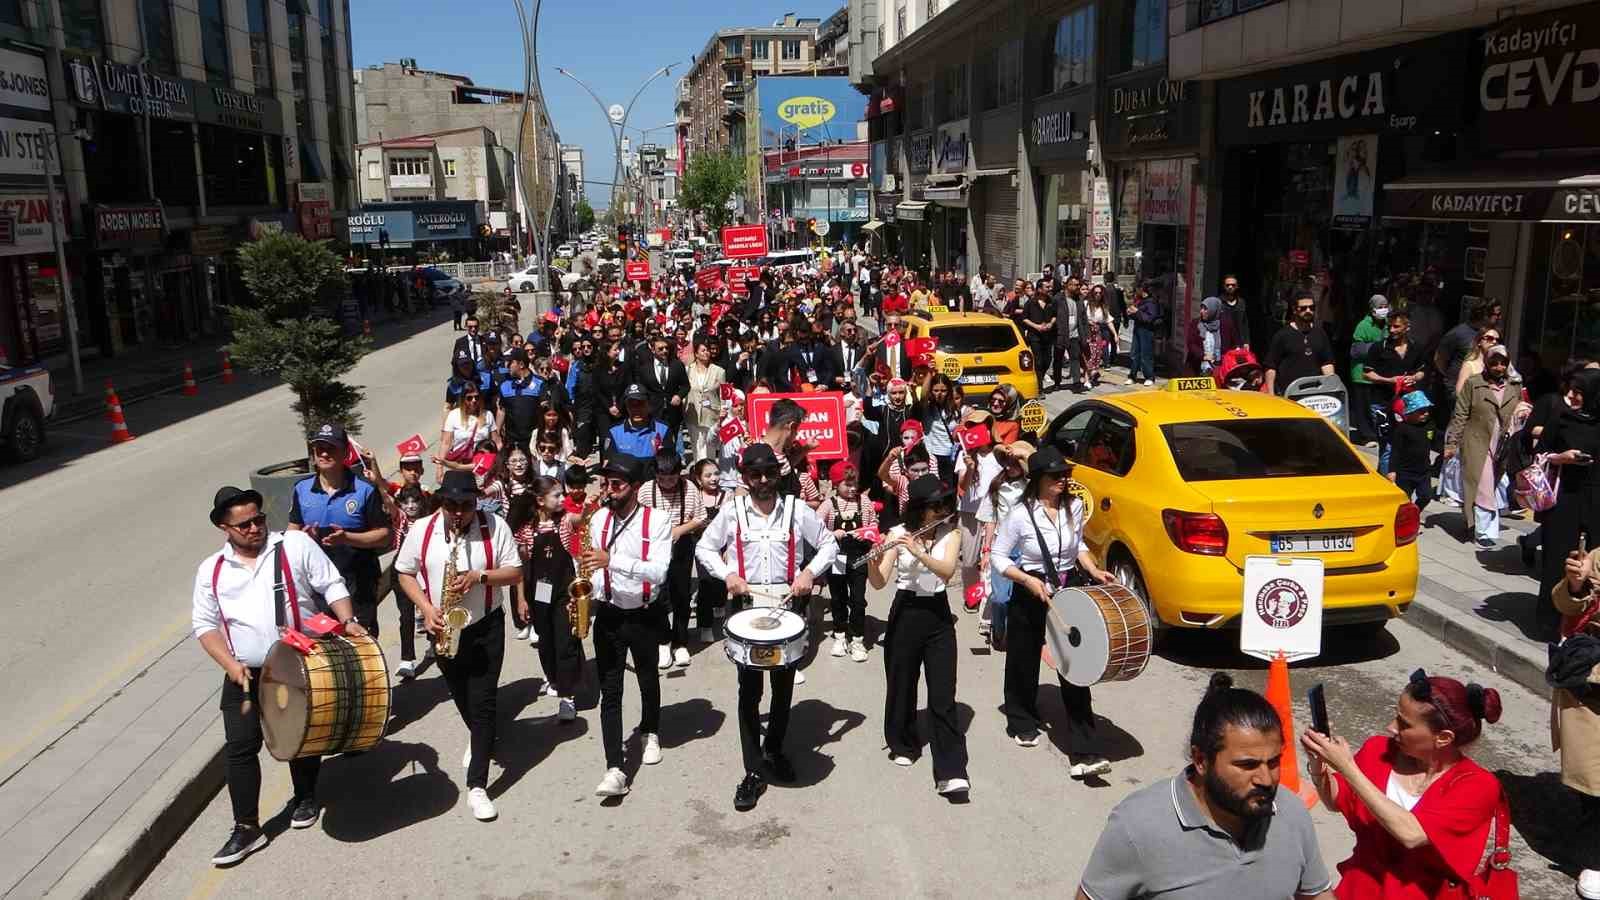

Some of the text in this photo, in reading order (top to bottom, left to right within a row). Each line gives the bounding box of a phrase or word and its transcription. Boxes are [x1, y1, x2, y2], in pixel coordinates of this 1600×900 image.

[1485, 20, 1577, 56] Kadayıfçı
[153, 75, 187, 104] DERYA
[1480, 48, 1600, 111] CEVD
[784, 100, 829, 118] gratis
[1248, 72, 1385, 128] KARACA
[1038, 112, 1071, 145] BARGELLO
[99, 213, 128, 231] ARDEN
[1278, 535, 1352, 551] 65 T 0134
